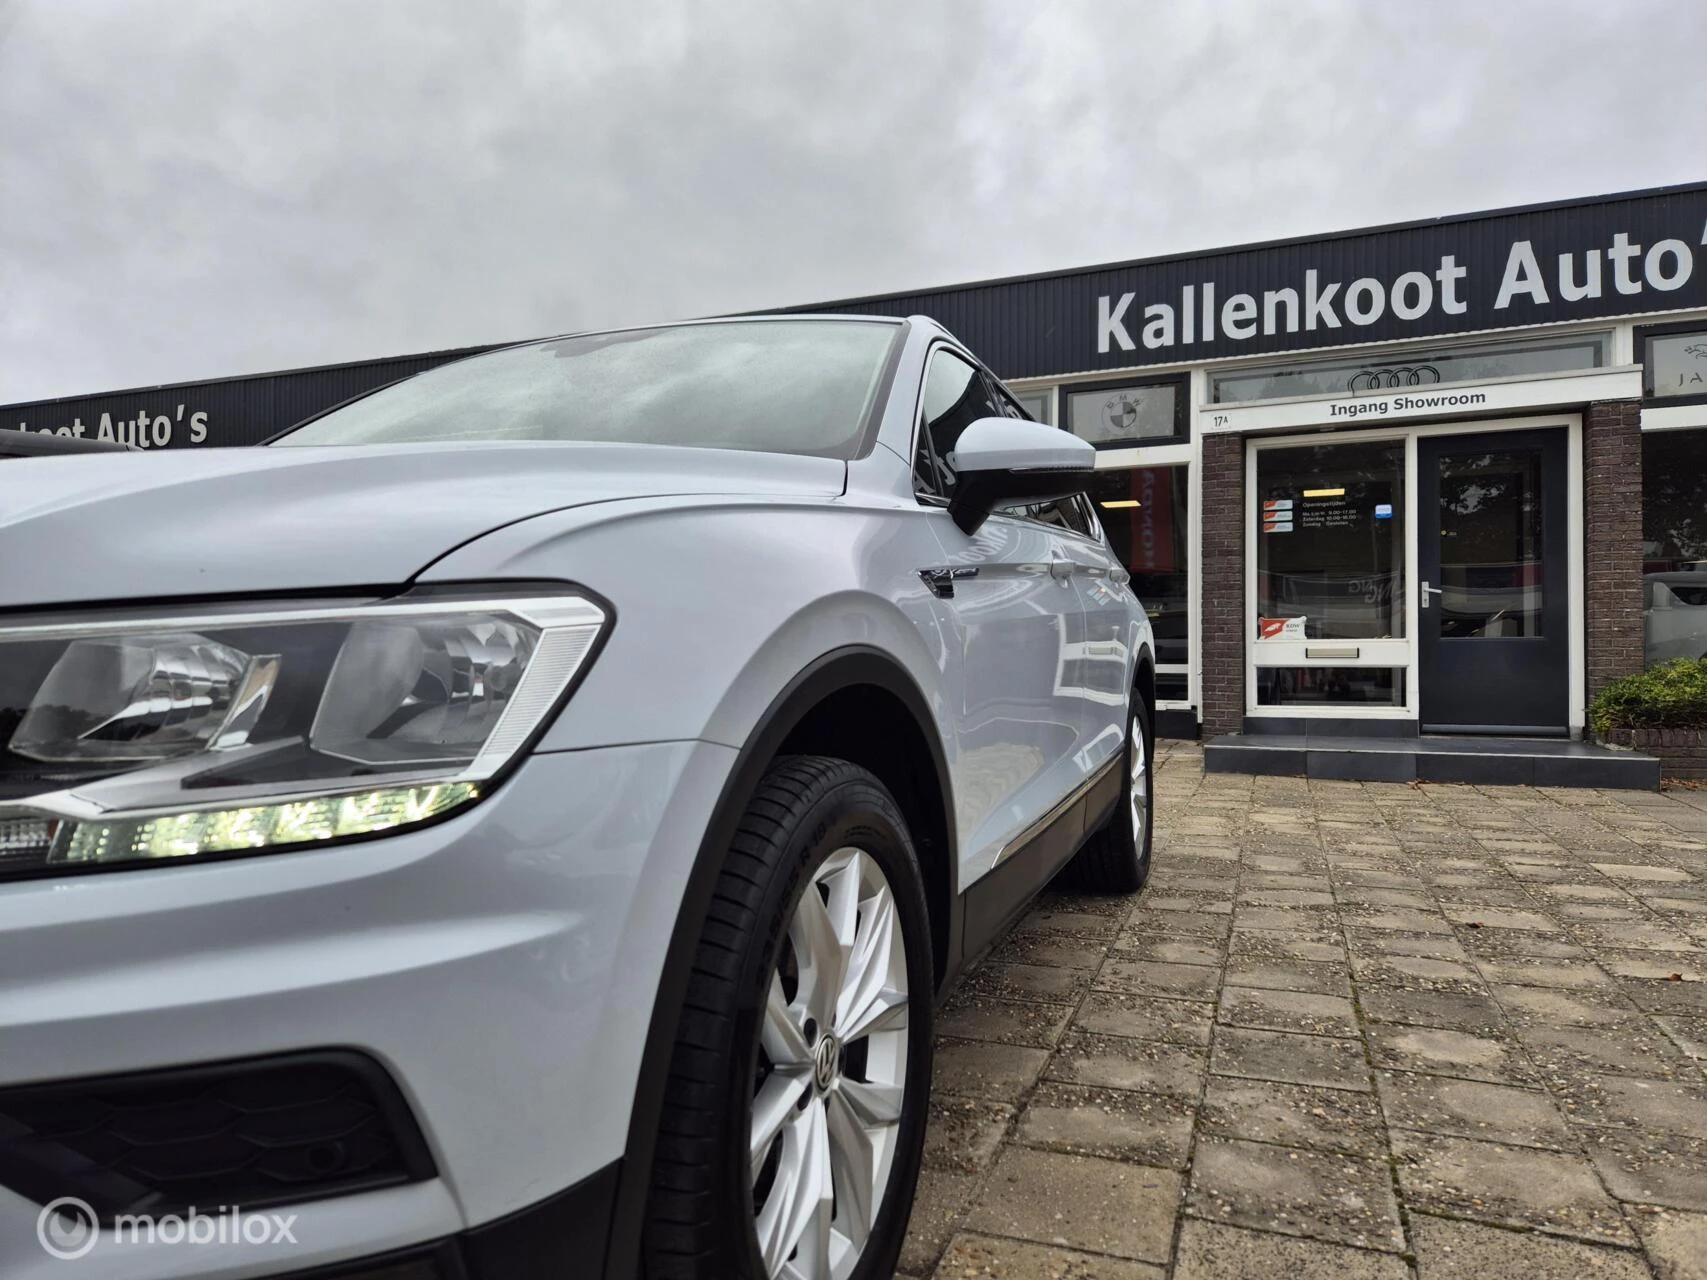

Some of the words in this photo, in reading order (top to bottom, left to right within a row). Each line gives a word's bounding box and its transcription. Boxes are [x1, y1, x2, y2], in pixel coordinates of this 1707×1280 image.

[1098, 255, 1467, 353] Kallenkoot
[97, 404, 208, 447] Auto's
[1330, 402, 1388, 417] Ingang
[1394, 393, 1486, 410] Showroom
